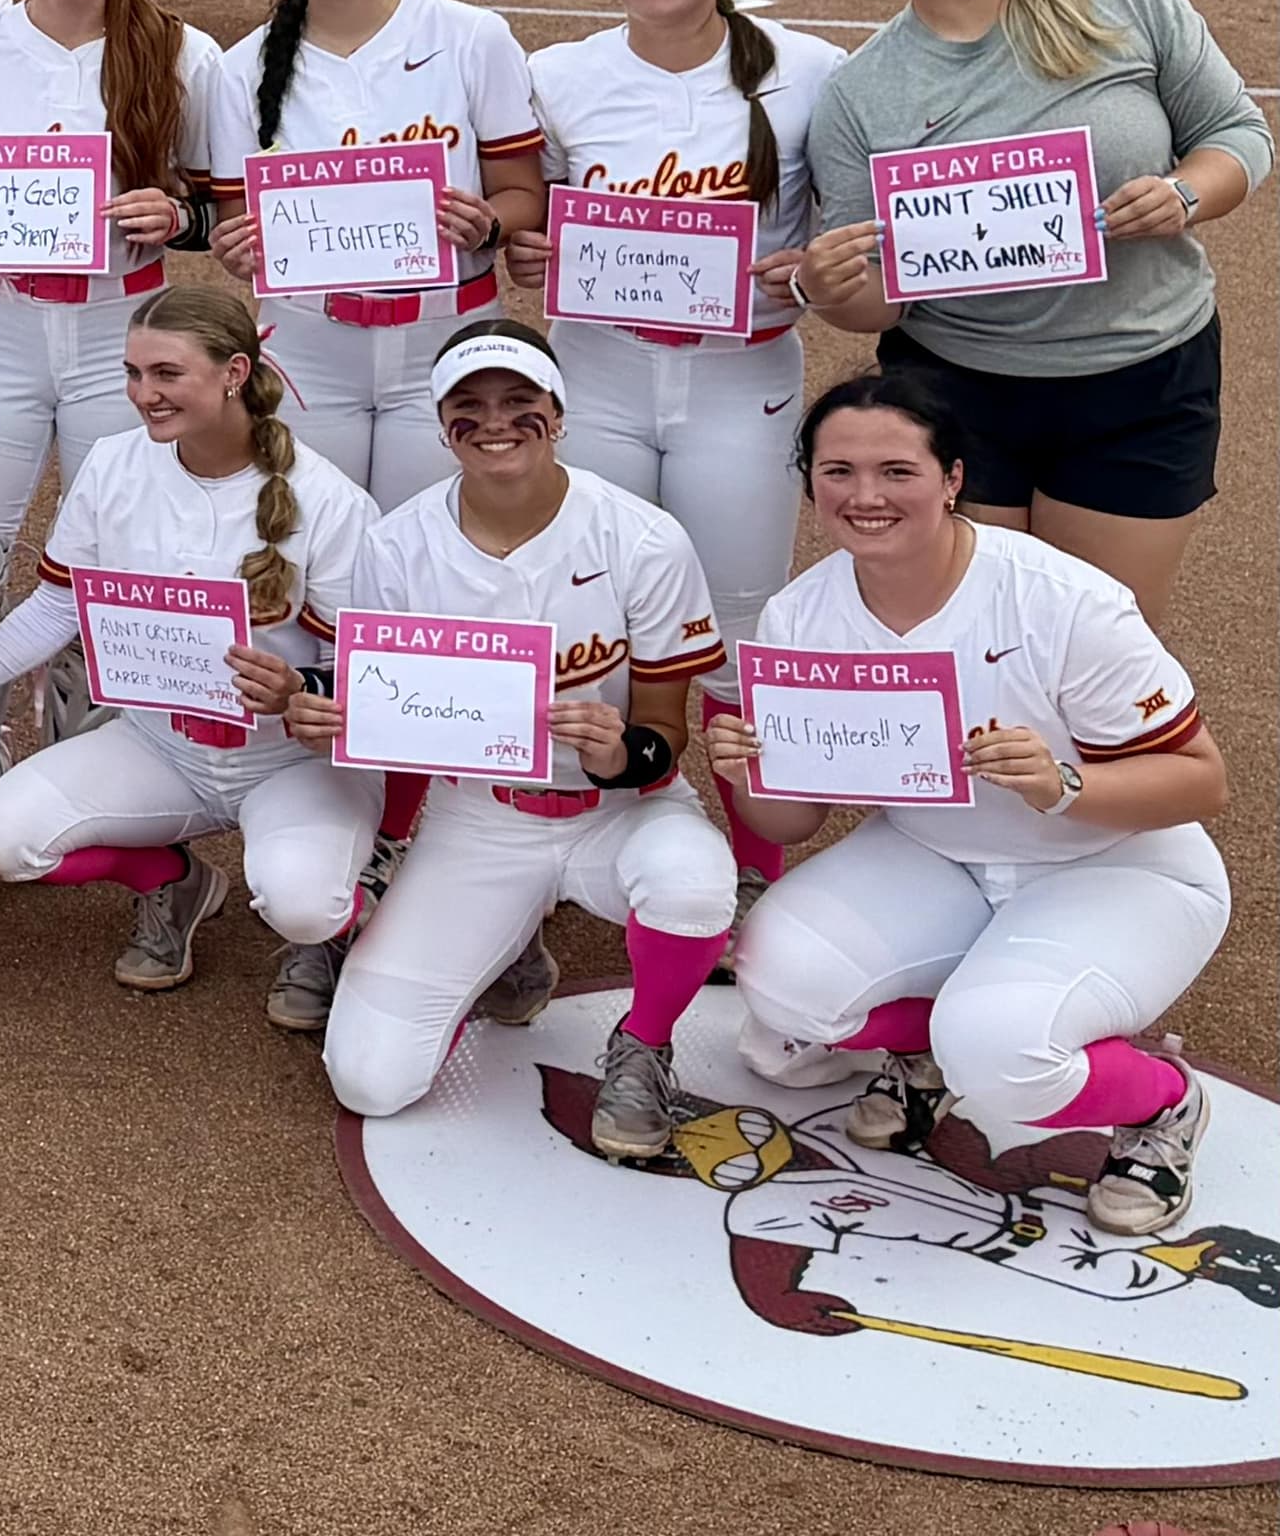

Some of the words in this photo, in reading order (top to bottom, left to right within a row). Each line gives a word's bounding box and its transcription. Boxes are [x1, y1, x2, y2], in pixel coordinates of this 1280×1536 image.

[27, 146, 92, 163] FOR...
[888, 166, 901, 185] I
[913, 156, 980, 182] PLAY
[992, 147, 1071, 173] FOR...
[260, 167, 272, 184] I
[282, 161, 343, 182] PLAY
[355, 156, 429, 176] FOR...
[272, 198, 327, 225] ALL
[894, 189, 973, 219] AUNT
[988, 179, 1072, 212] SHELLY
[564, 199, 576, 217] I
[587, 203, 650, 225] PLAY
[662, 210, 737, 231] FOR...
[11, 222, 58, 256] Sherry
[308, 222, 419, 252] FIGHTERS
[579, 242, 607, 271] My
[616, 245, 689, 267] Grandma
[900, 249, 979, 277] SARA
[614, 288, 663, 303] Nana
[84, 579, 95, 596] I
[103, 581, 154, 604] PLAY
[164, 588, 230, 611] FOR...
[100, 617, 140, 637] AUNT
[145, 624, 211, 646] CRYSTAL
[352, 624, 365, 644] I
[376, 625, 444, 649] PLAY
[455, 632, 535, 657] FOR...
[103, 640, 157, 661] EMILY
[106, 668, 152, 686] CARRIE
[358, 665, 399, 700] My
[752, 658, 764, 677] I
[775, 660, 840, 682] PLAY
[853, 665, 938, 684] FOR...
[401, 692, 485, 722] Grandma
